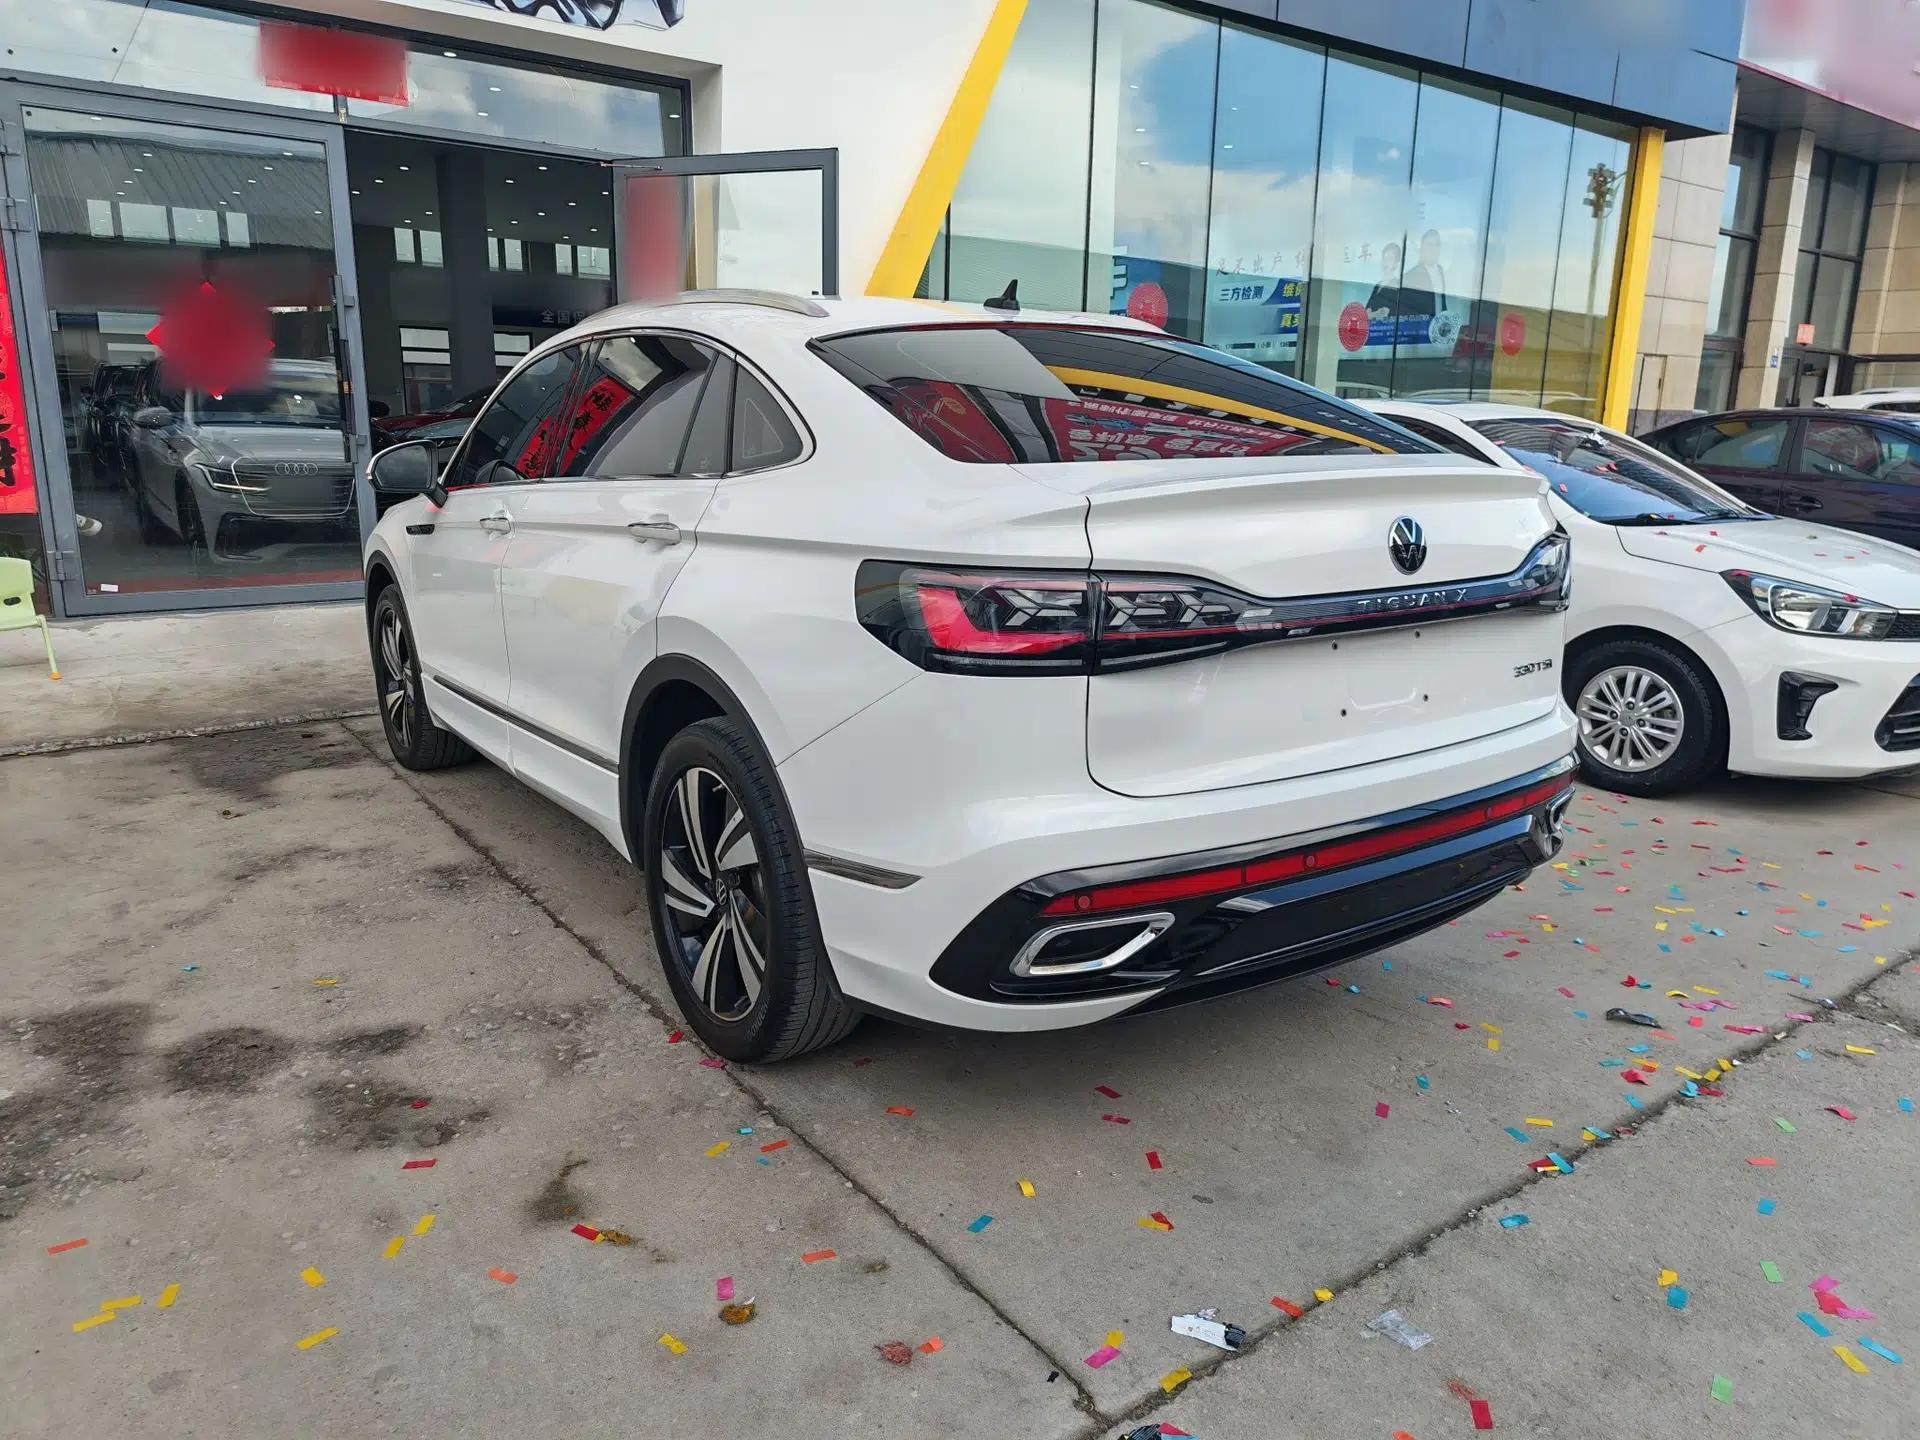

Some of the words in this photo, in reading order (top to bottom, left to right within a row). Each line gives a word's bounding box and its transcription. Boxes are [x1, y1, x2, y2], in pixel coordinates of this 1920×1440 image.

[1219, 285, 1264, 302] 三方检测
[1357, 591, 1447, 613] TIGUAN
[1456, 588, 1468, 602] X
